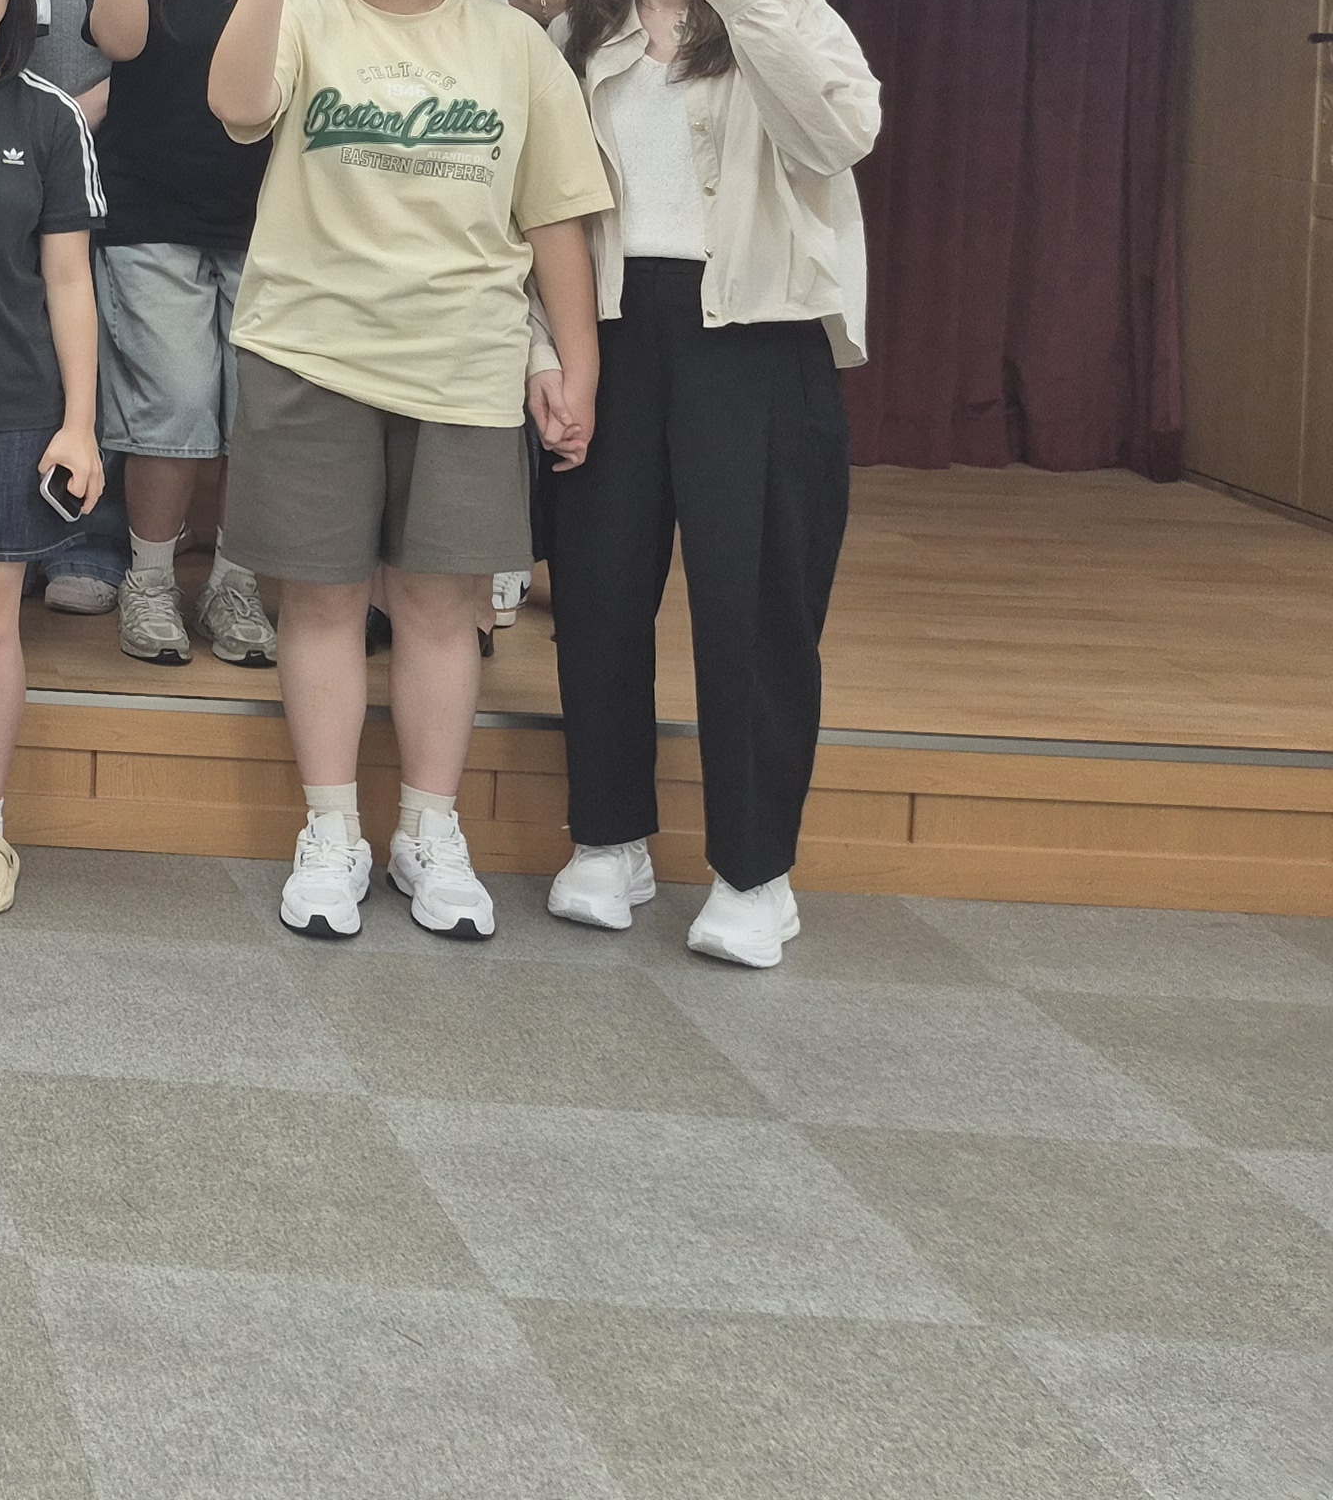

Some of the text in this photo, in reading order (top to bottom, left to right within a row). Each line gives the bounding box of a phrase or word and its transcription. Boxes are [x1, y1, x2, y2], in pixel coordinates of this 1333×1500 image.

[357, 62, 456, 91] CELTICS
[386, 84, 427, 98] 1946
[304, 87, 504, 145] Boston Celtics
[341, 147, 412, 174] EASTERN
